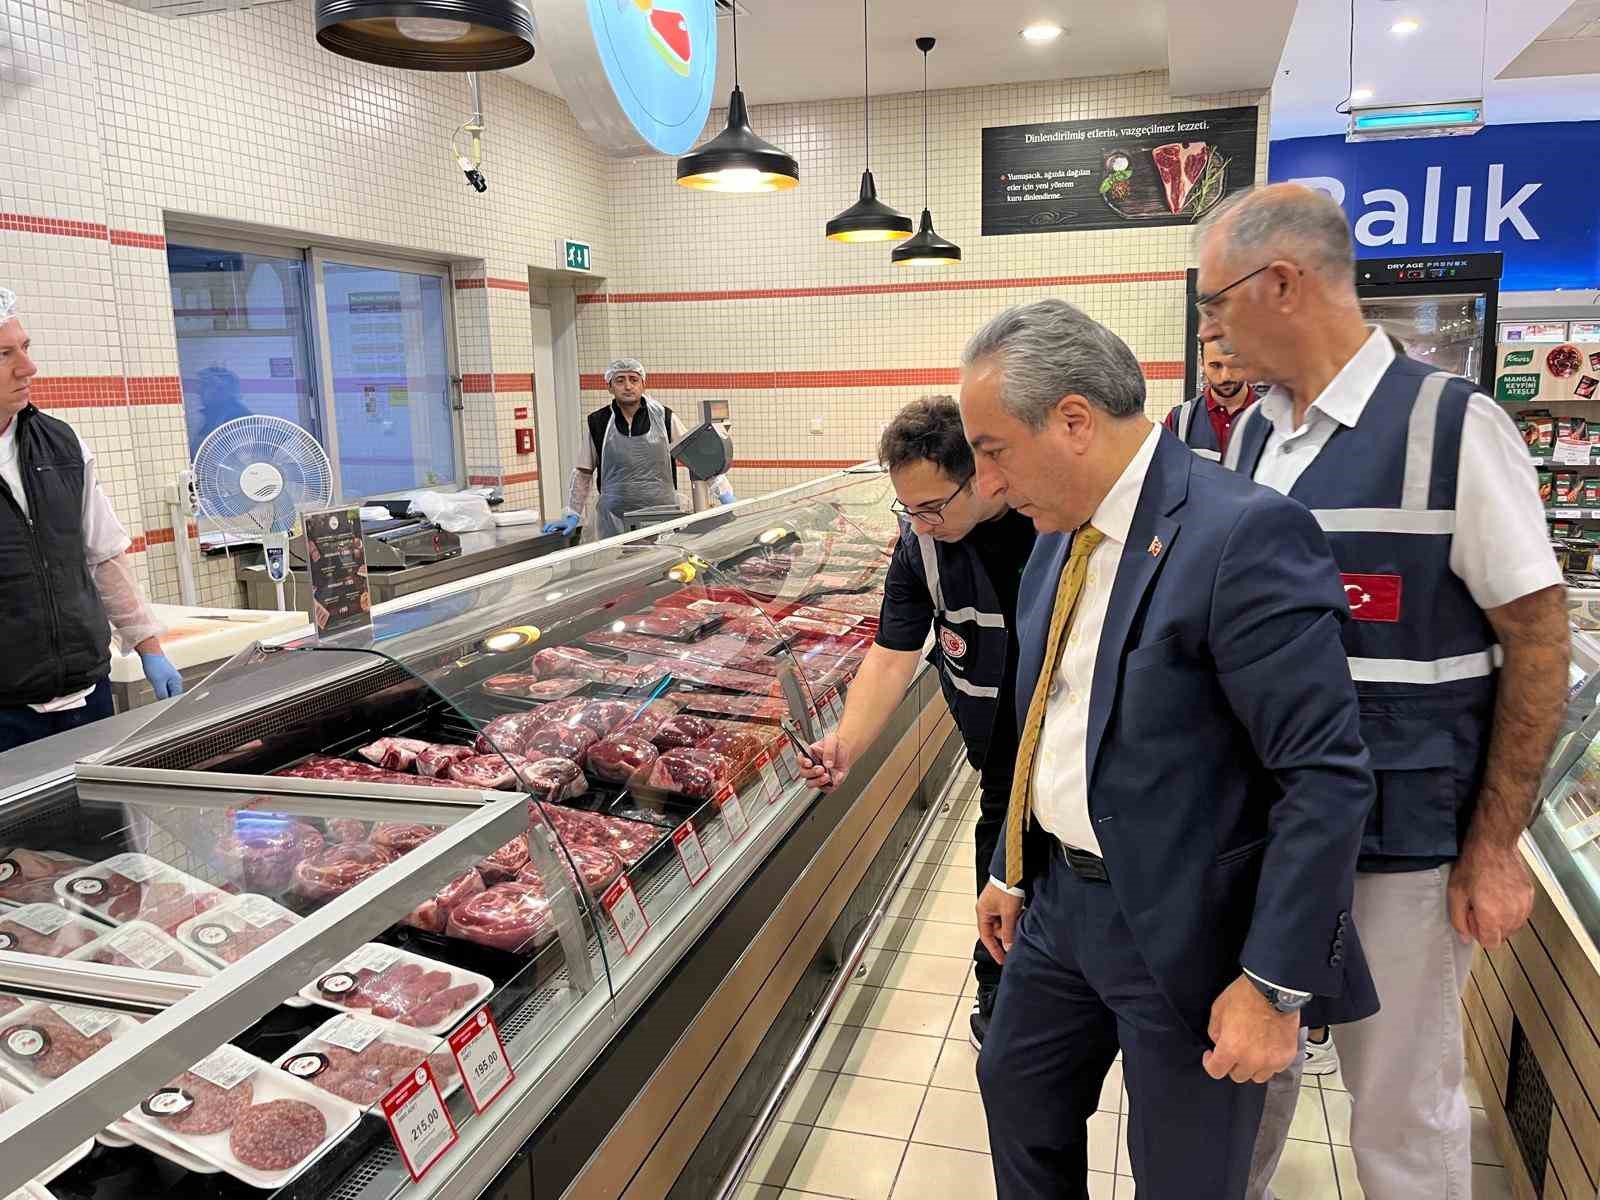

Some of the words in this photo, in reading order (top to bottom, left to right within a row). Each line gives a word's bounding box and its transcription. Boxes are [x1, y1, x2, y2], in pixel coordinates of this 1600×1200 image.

[1025, 130, 1086, 144] Dinlendirilmiş
[1087, 128, 1118, 138] etlerin,
[1121, 122, 1175, 137] vazgeçilmez
[1177, 120, 1210, 132] lezzeti.
[411, 1108, 440, 1141] 215.00
